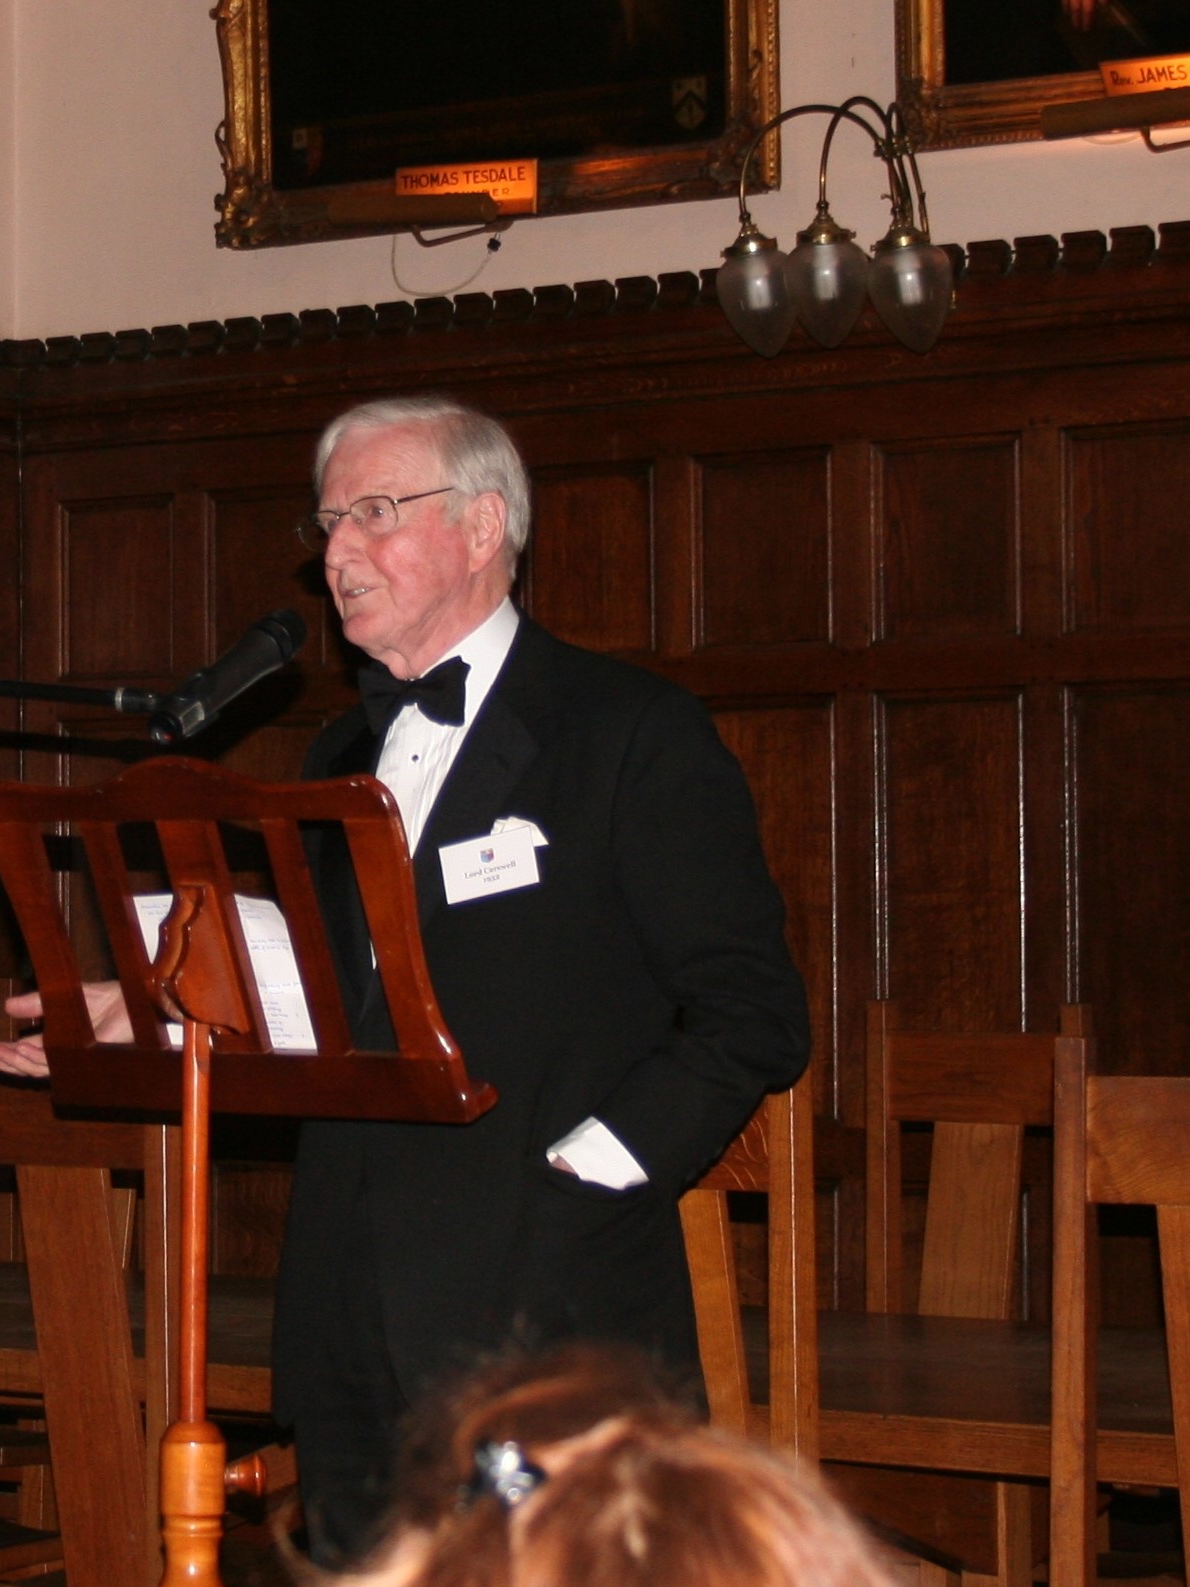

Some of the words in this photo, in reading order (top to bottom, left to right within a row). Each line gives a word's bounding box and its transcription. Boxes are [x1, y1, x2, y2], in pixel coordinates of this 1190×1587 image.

[1137, 64, 1188, 84] JAMES
[401, 171, 459, 189] THOMAS
[463, 166, 526, 185] TESDALE
